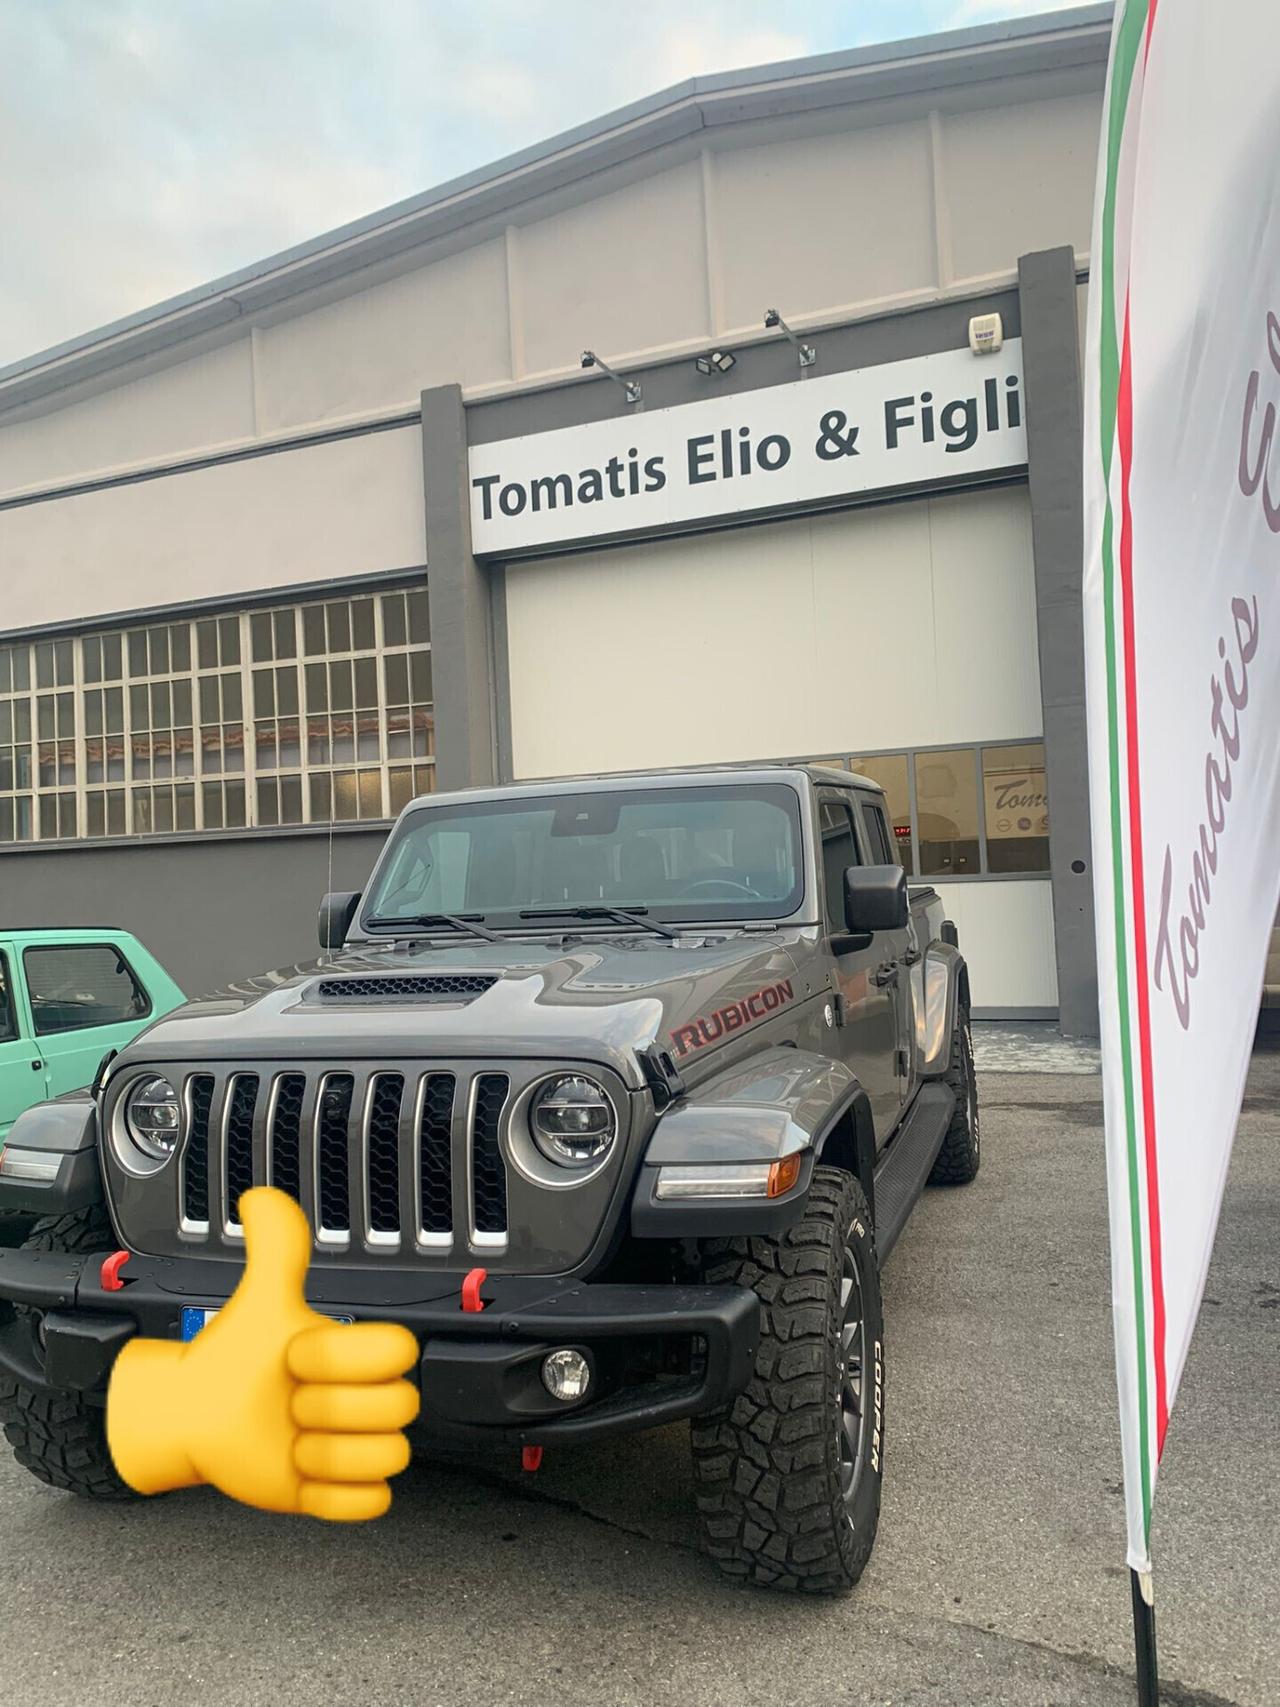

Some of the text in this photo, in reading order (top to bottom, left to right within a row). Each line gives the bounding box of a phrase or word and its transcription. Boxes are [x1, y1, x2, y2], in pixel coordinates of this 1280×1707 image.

[472, 374, 1021, 520] Tomatis Elio & Figli
[1154, 594, 1259, 1031] Tomatis
[669, 978, 795, 1058] RUBICON
[871, 1340, 882, 1473] COOPER
